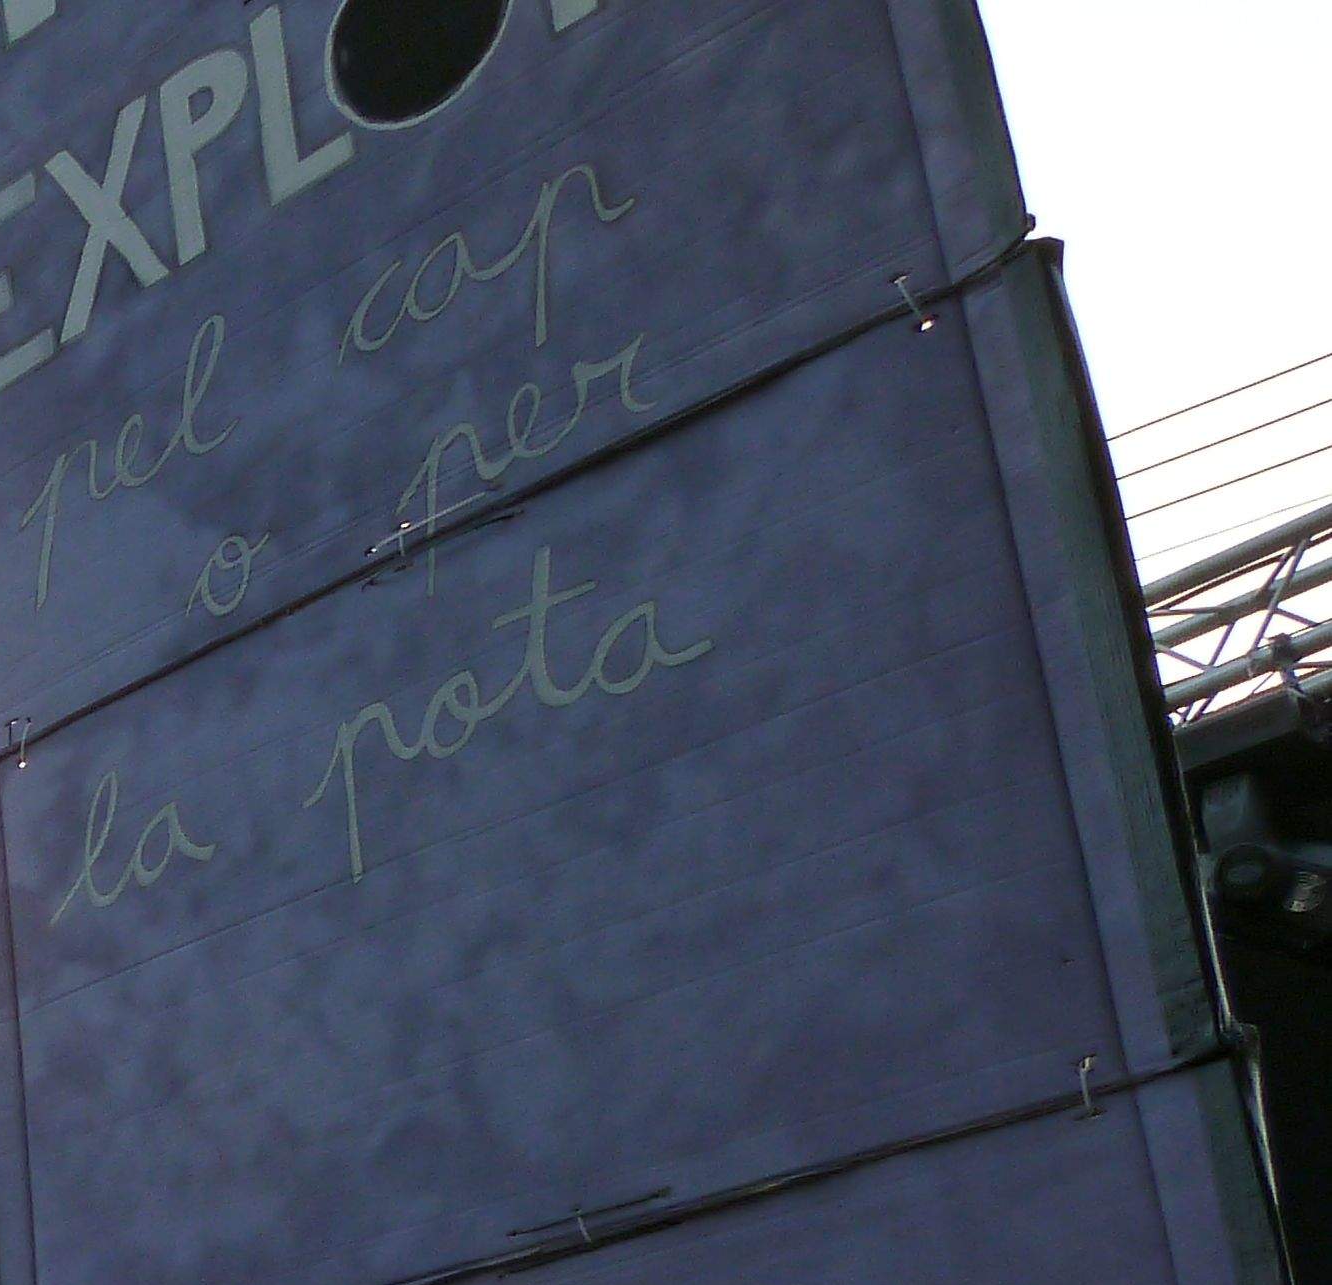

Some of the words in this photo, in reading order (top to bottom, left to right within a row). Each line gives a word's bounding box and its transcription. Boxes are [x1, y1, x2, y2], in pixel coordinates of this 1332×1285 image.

[19, 314, 239, 611] pel
[338, 163, 636, 364] cap
[187, 530, 270, 617] o
[396, 334, 658, 597] per
[50, 771, 215, 924] la
[303, 546, 715, 884] pota
